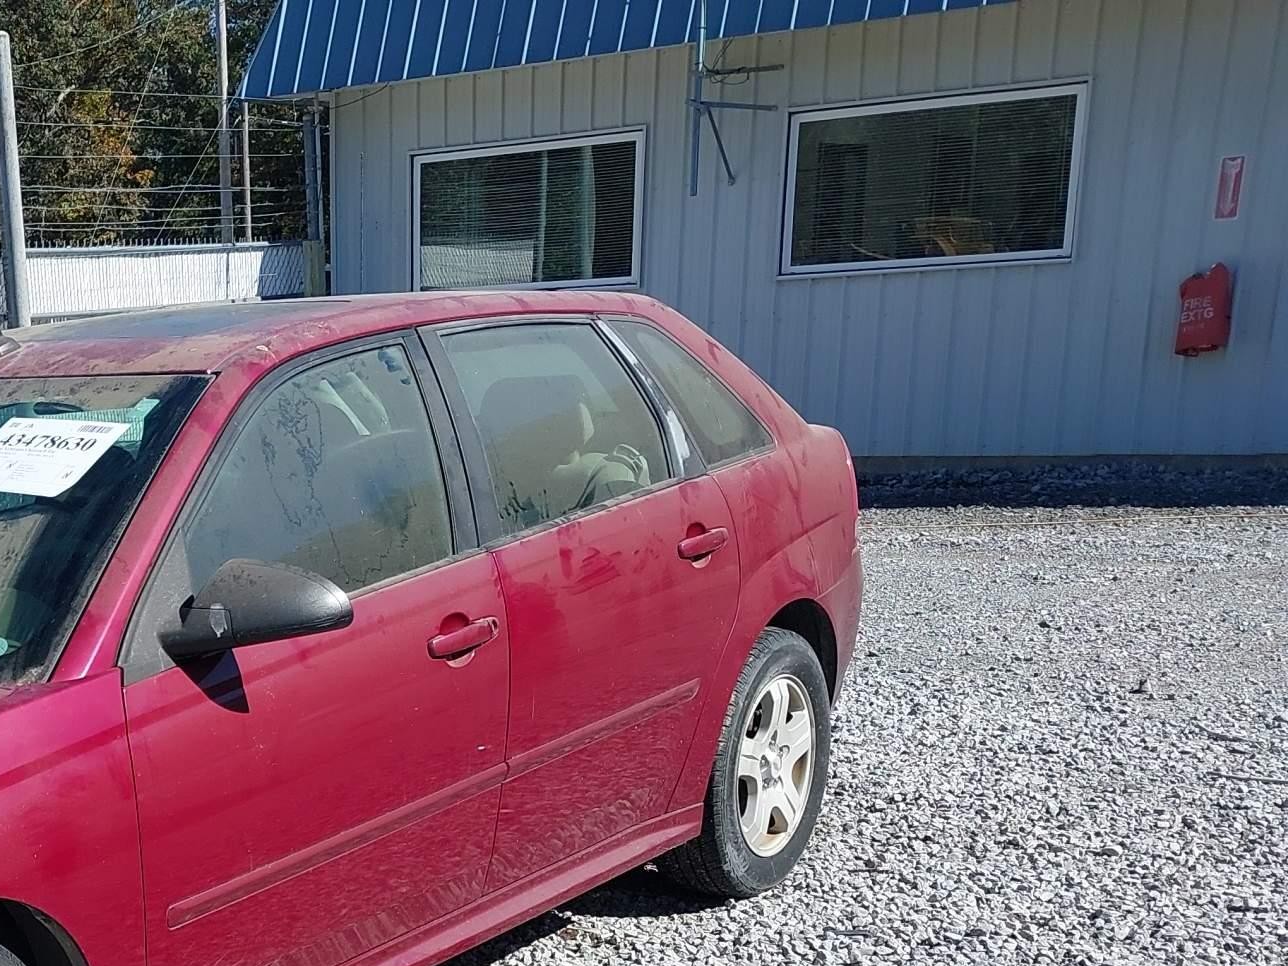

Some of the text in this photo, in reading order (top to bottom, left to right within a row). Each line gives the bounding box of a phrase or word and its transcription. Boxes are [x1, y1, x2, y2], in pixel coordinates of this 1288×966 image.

[1184, 296, 1212, 310] FIRE
[1181, 307, 1214, 323] EXTG
[0, 433, 97, 452] 43478630
